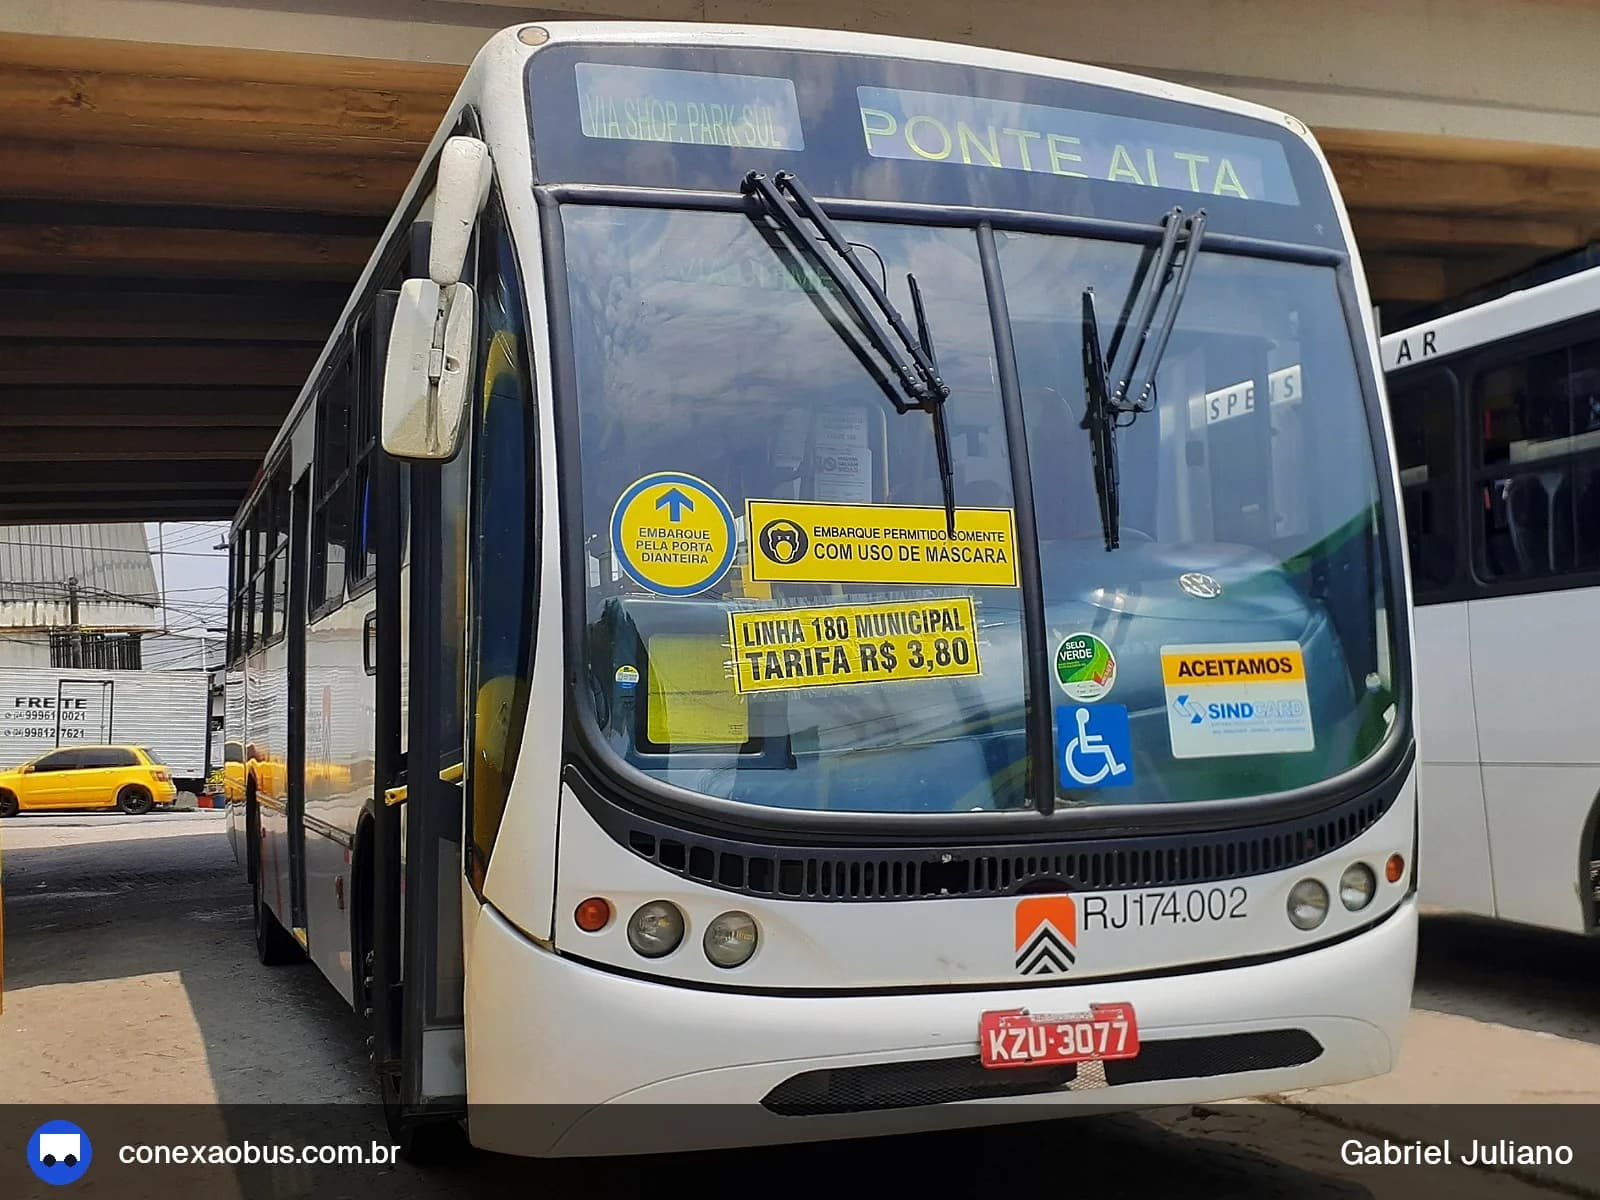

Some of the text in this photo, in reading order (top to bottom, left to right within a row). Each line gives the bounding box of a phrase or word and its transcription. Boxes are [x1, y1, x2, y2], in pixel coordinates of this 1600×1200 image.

[586, 94, 621, 138] VIA
[688, 102, 740, 146] PARK
[741, 102, 782, 147] SUL
[862, 107, 1089, 179] PONTE
[1396, 331, 1437, 365] AR
[639, 527, 710, 540] EMBARQUE
[814, 526, 1005, 543] EMBARQUE PERMITIDO SOMENTE
[636, 540, 714, 553] PELA PORTA
[814, 542, 1007, 564] COM USO DE MÁSCARA
[641, 552, 708, 564] DIANTEIRA
[743, 607, 965, 647] LINHA 180 MUNICIPAL
[1059, 648, 1093, 661] VERDE
[1065, 640, 1086, 650] SELO
[745, 636, 970, 681] TARIFA R$ 3,80
[1178, 656, 1293, 678] ACEITAMOS
[15, 697, 87, 709] FRETE
[1208, 698, 1304, 720] SINDCARD
[62, 711, 86, 720] 0021
[60, 728, 85, 738] 7621
[1084, 886, 1248, 931] RJ174.002
